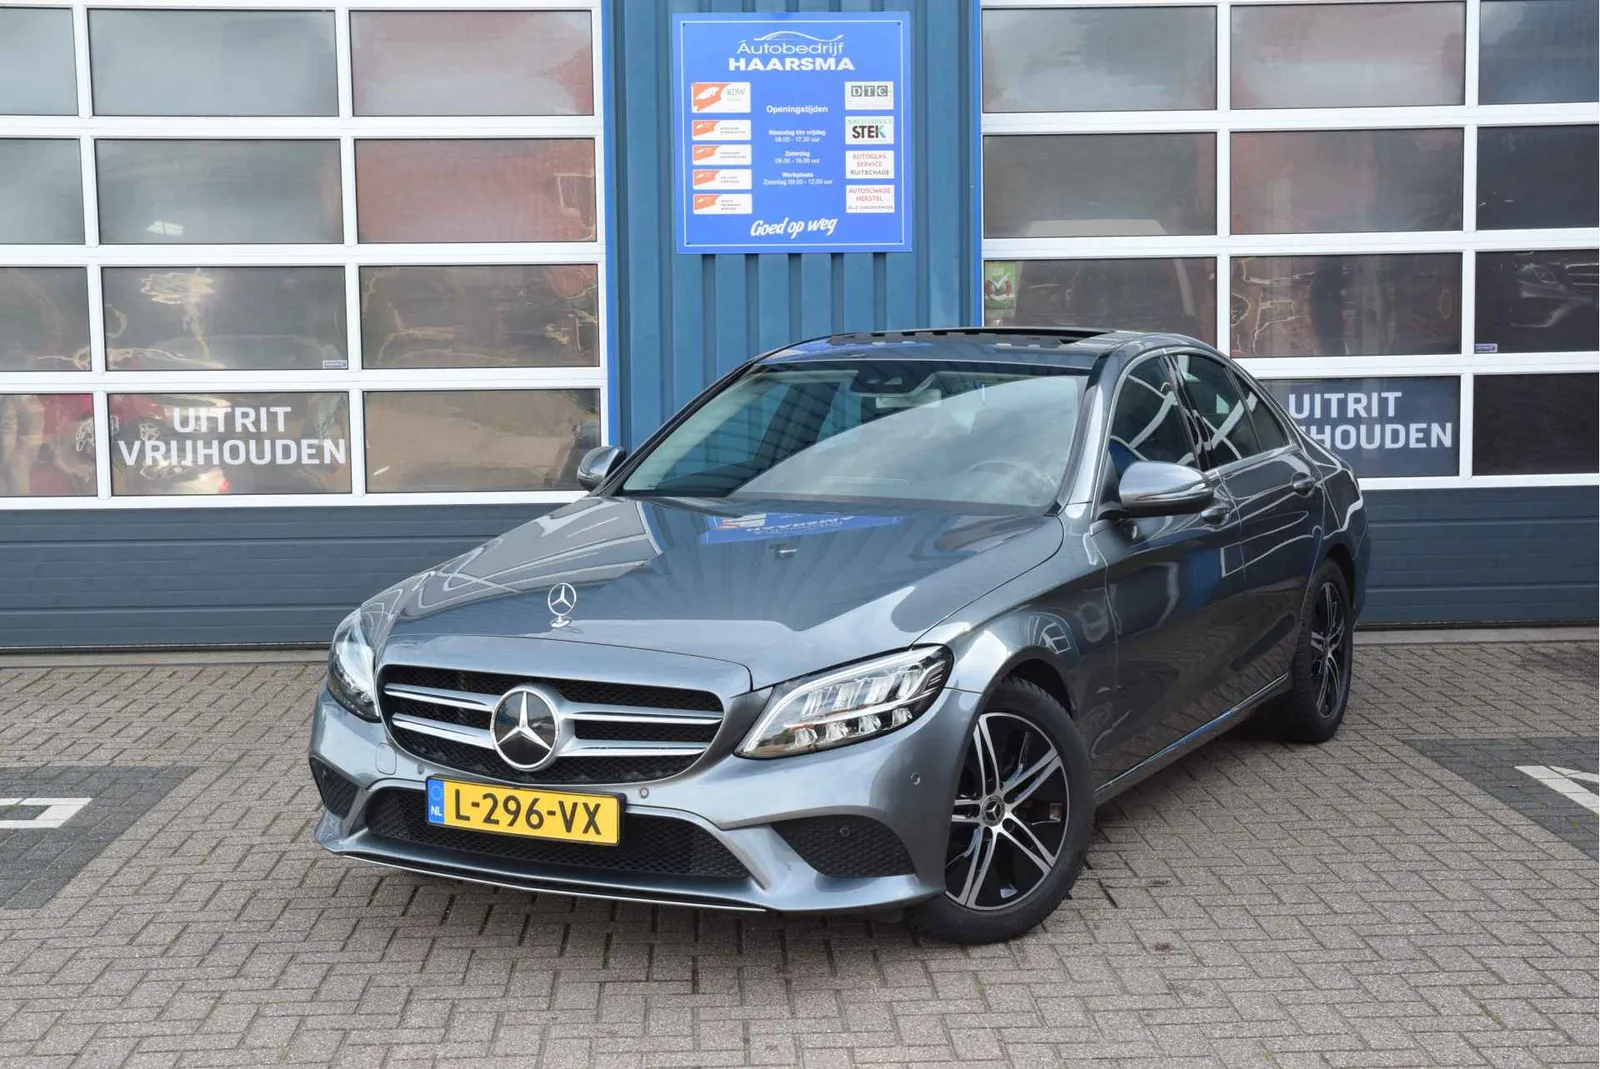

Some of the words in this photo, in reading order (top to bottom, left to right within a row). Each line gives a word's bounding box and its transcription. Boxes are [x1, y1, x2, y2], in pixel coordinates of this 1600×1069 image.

[736, 40, 845, 57] Autobedrijf
[728, 57, 855, 71] HAARSMA
[851, 85, 888, 97] DTC
[766, 105, 829, 114] Openingstijden
[852, 125, 886, 139] STEK
[750, 217, 789, 236] Goed
[788, 221, 805, 239] op
[807, 218, 839, 236] weg
[1289, 392, 1402, 419] UITRIT
[172, 406, 292, 433] UITRIT
[1300, 423, 1453, 450] HOUDEN
[118, 438, 347, 466] VRIJHOUDEN
[430, 806, 443, 817] NL
[454, 789, 602, 835] L-296-VX
